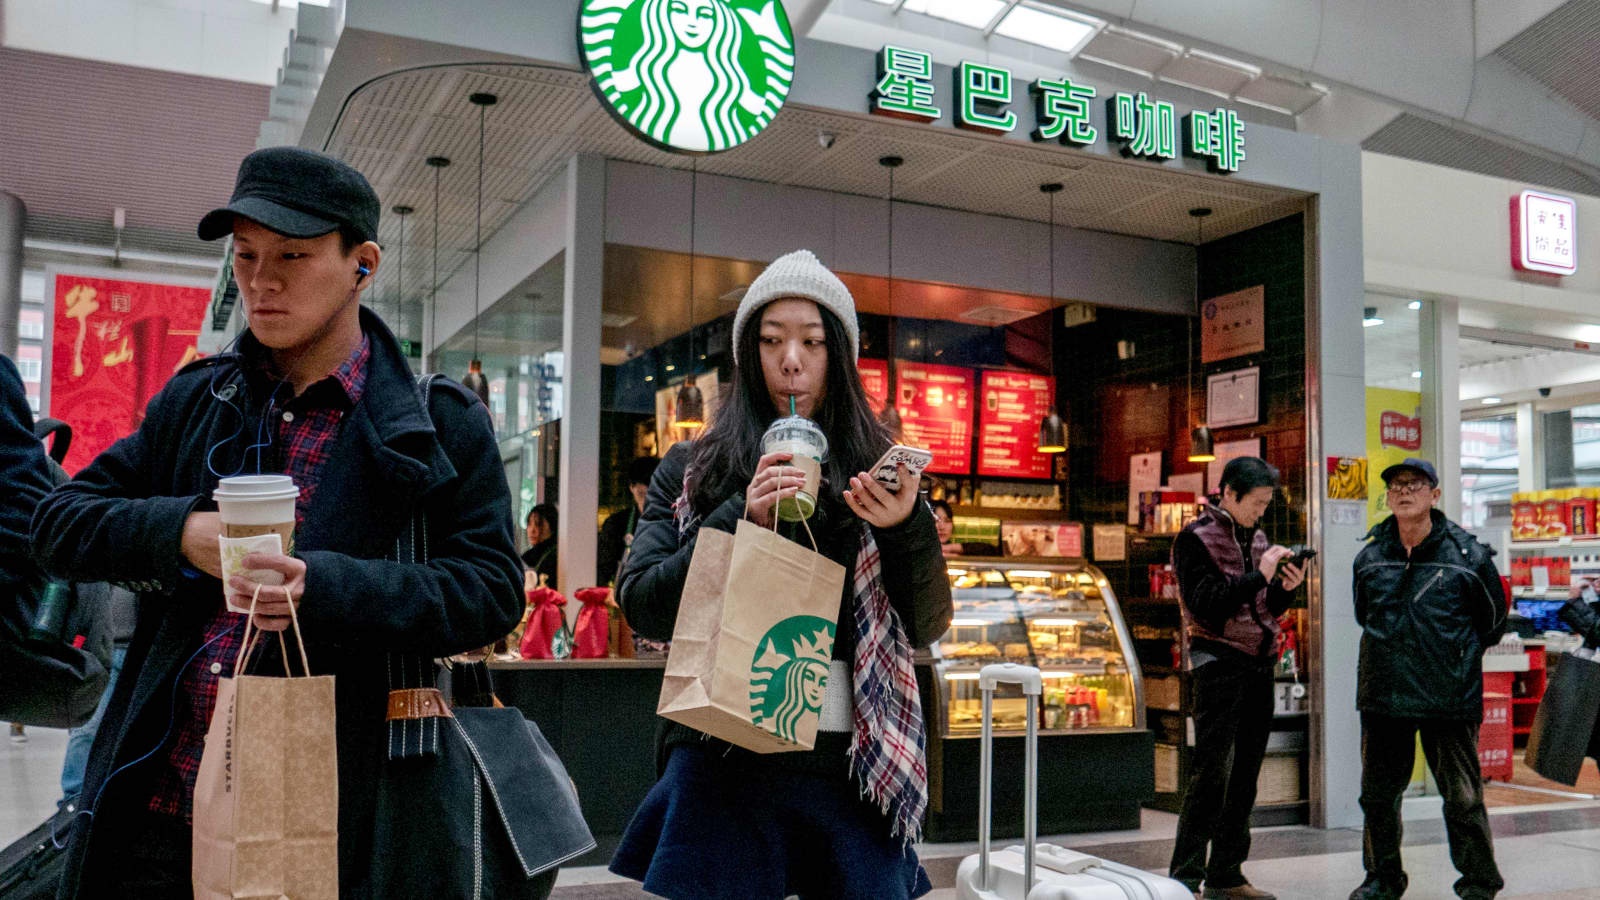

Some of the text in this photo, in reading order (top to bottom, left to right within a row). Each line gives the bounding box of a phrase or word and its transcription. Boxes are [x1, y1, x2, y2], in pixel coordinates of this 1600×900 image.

[877, 45, 1246, 173] 星巴克咖啡
